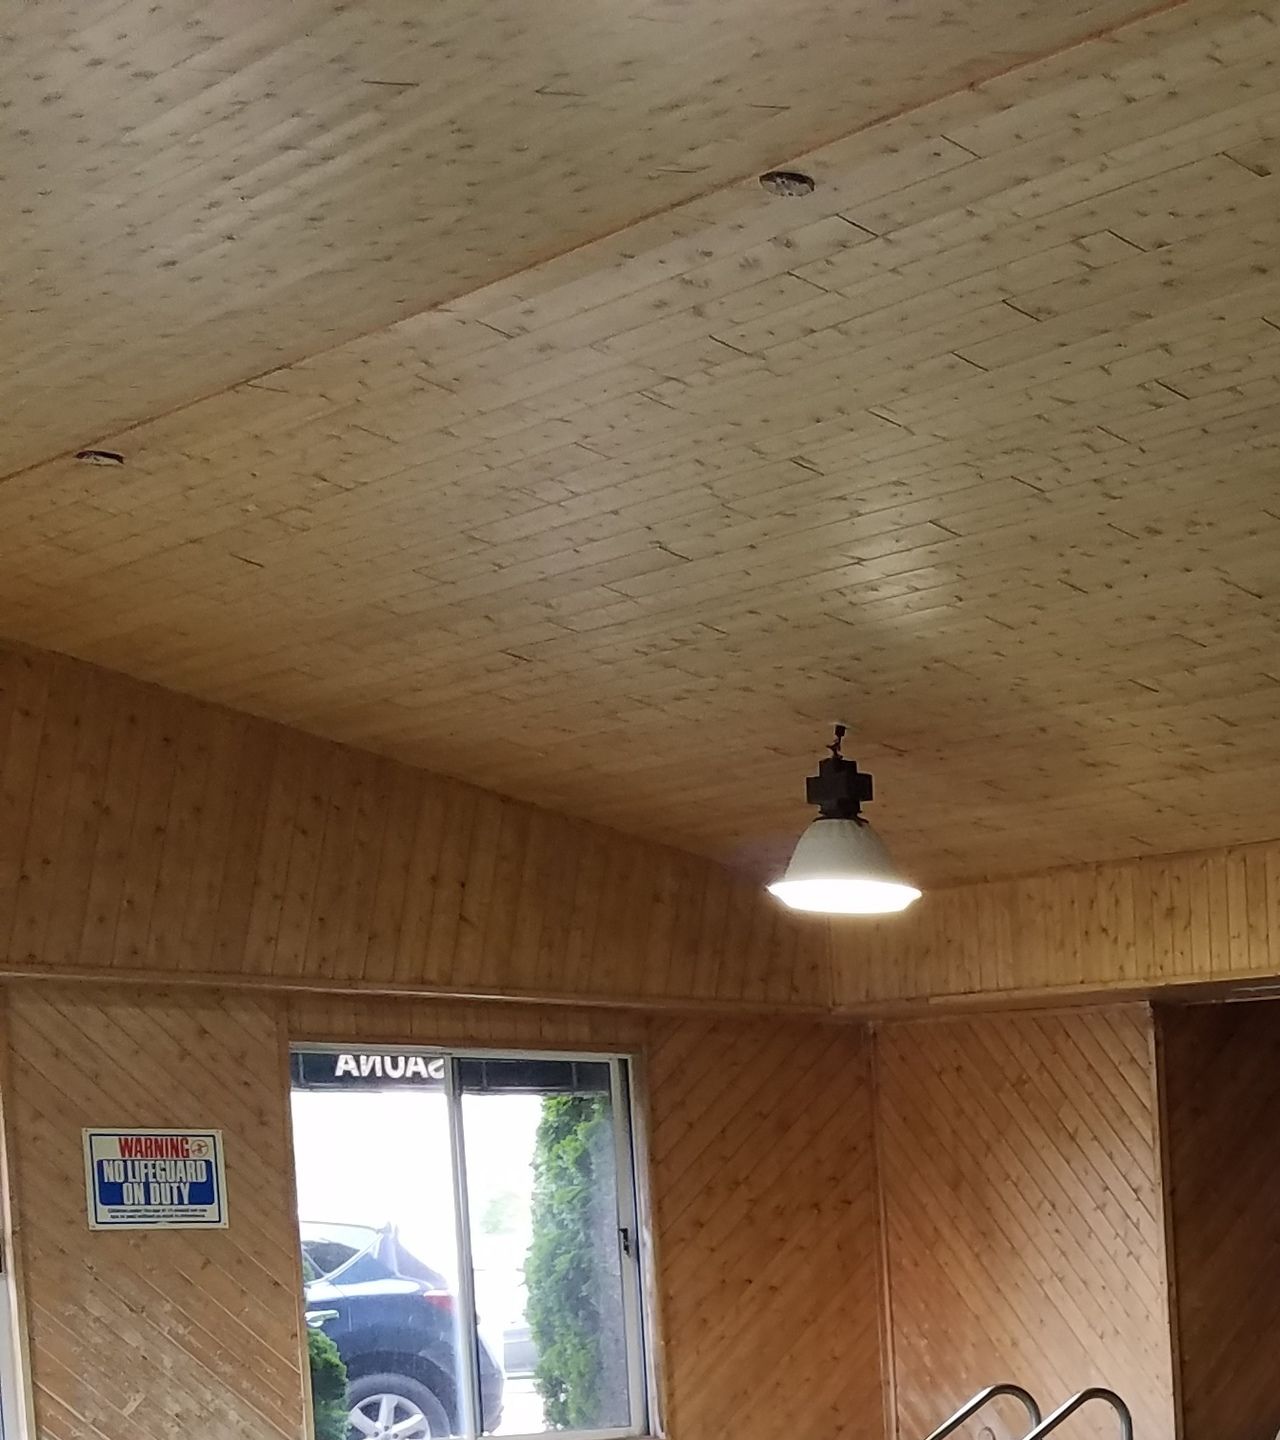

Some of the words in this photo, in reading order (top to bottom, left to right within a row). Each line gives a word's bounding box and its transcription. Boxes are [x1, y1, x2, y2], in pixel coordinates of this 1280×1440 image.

[118, 1136, 190, 1159] WARNING
[102, 1160, 125, 1183] NO
[126, 1160, 208, 1183] LIFEGUARD
[122, 1182, 146, 1205] ON
[149, 1182, 191, 1205] DUTY
